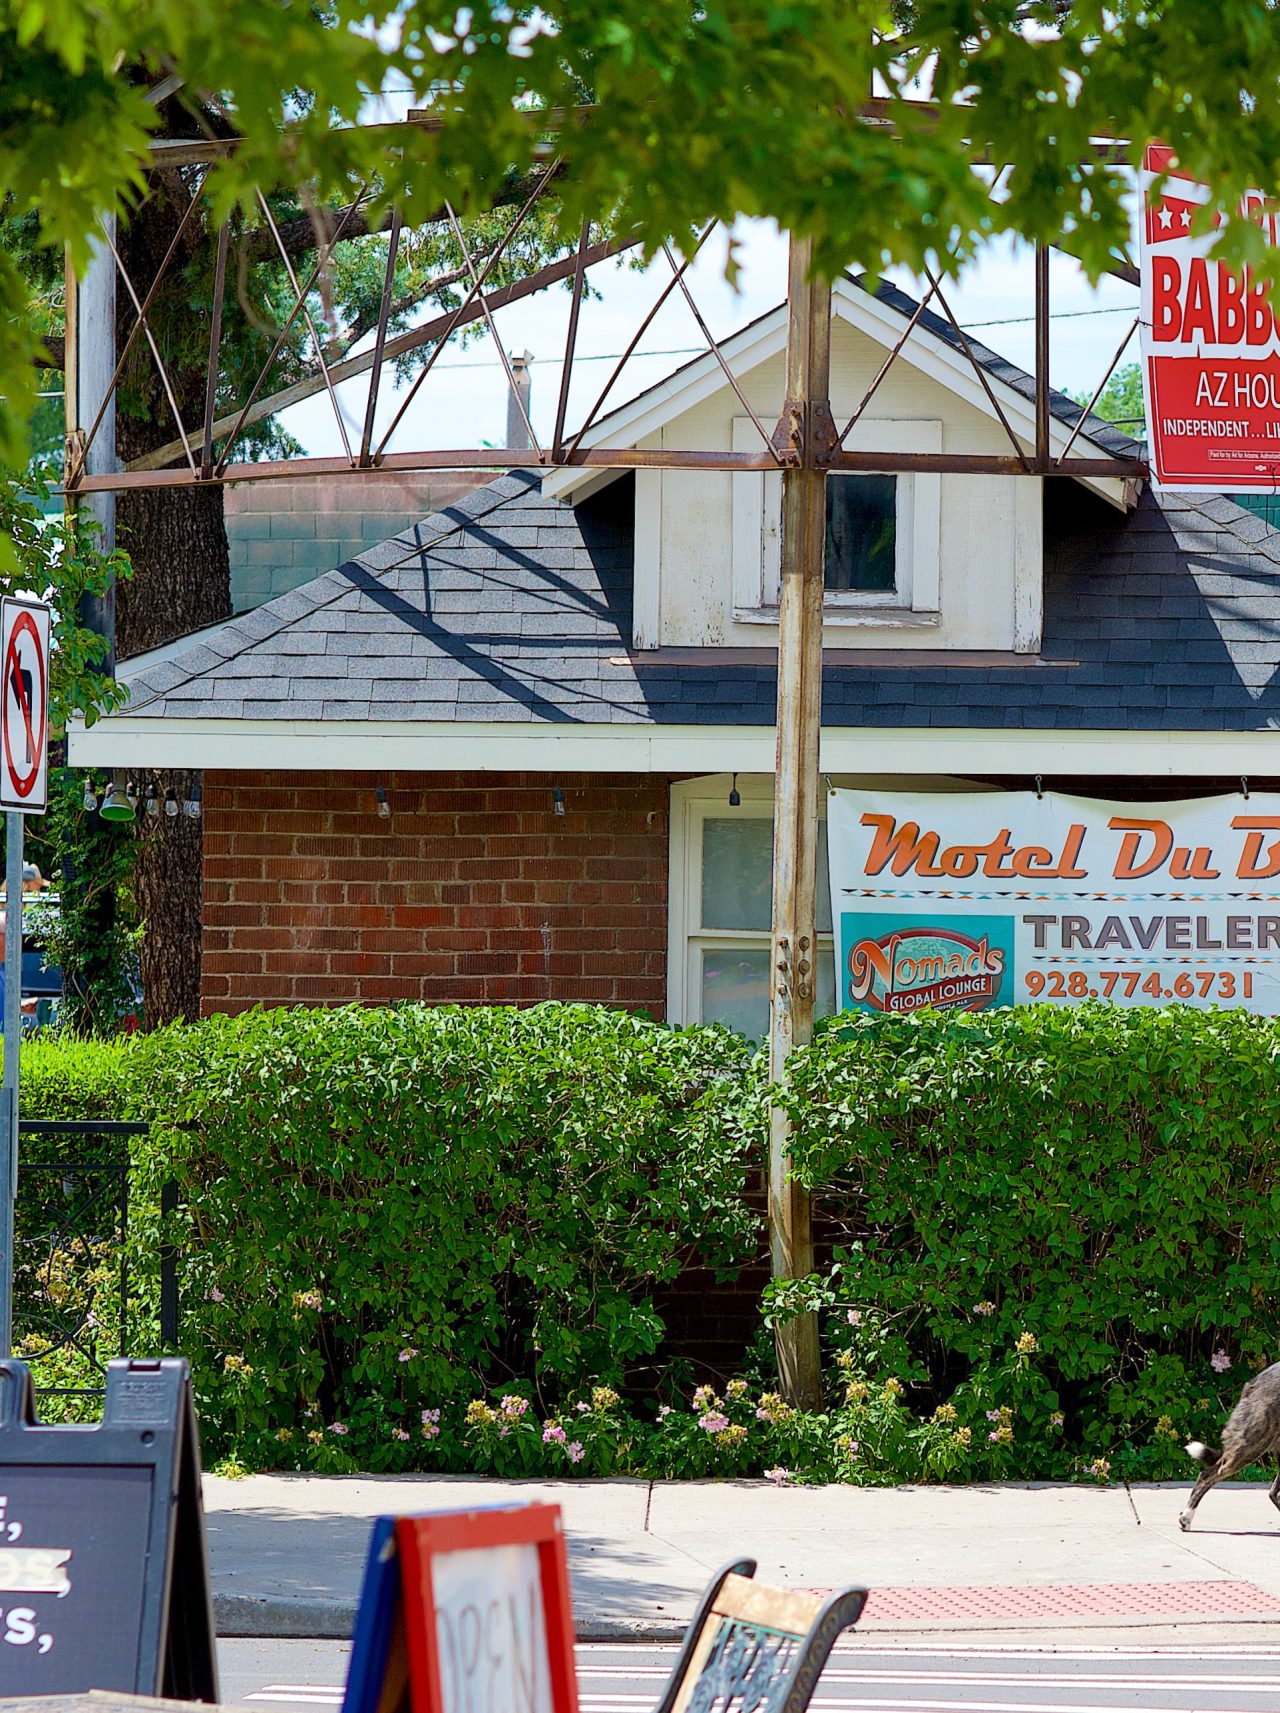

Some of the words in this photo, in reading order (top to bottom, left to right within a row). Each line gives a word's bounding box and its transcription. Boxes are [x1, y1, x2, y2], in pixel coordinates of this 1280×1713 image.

[1195, 371, 1229, 407] AZ
[859, 812, 1088, 879] Motel
[1105, 816, 1220, 880] Du
[851, 934, 1004, 1000] Nomads
[1024, 970, 1253, 999] 928.774.6731
[889, 991, 936, 1011] GLOBAL
[939, 977, 988, 1001] LOUNGE
